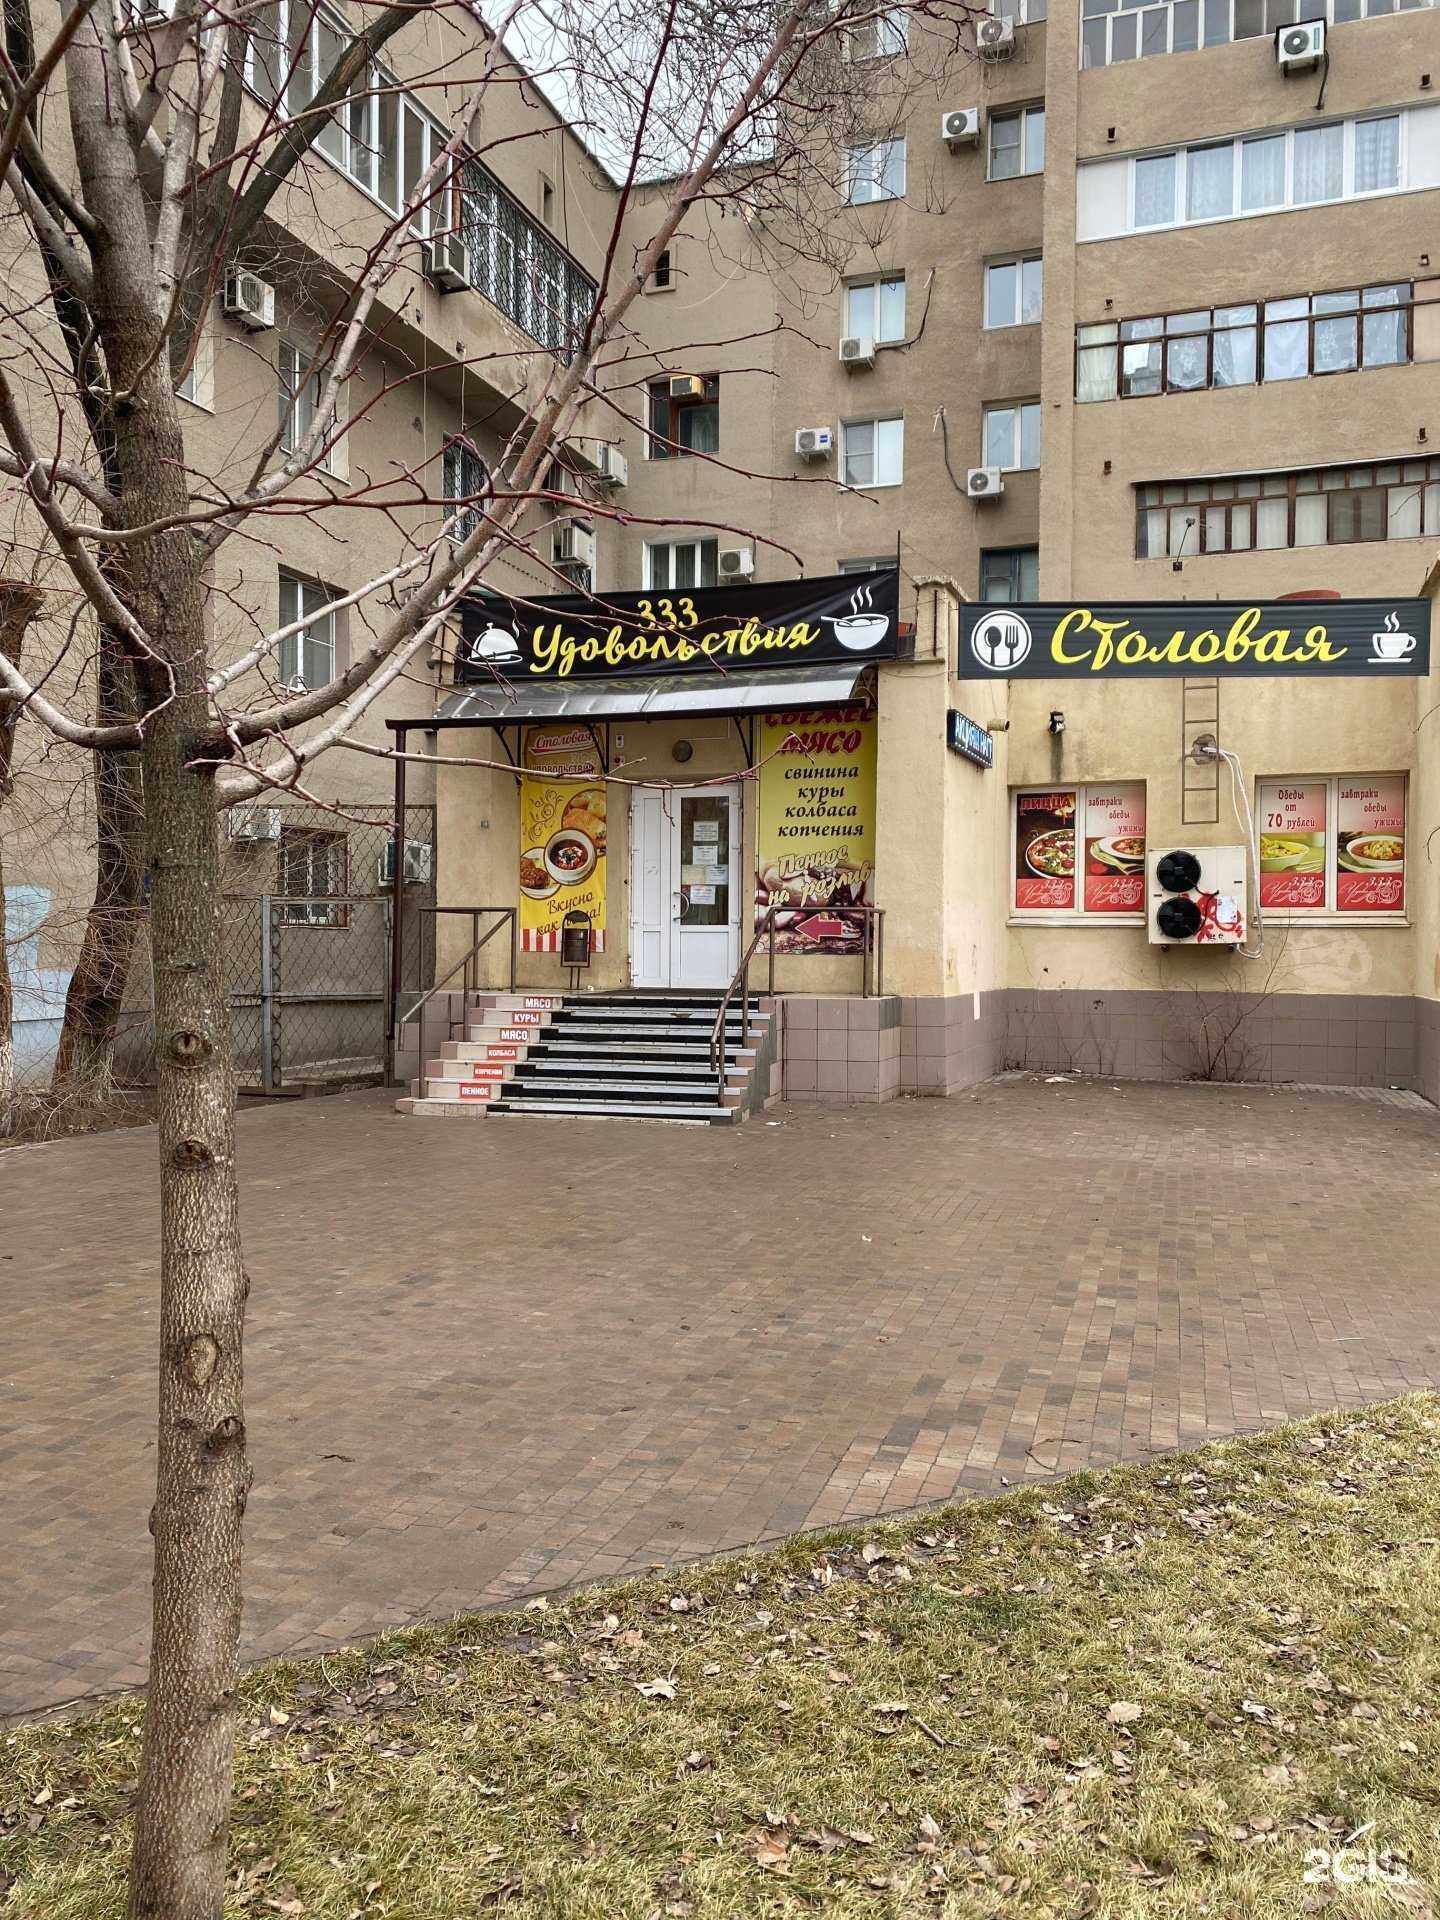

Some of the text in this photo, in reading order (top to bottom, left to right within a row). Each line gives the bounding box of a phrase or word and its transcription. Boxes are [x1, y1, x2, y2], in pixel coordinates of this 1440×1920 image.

[637, 598, 699, 630] 333
[1051, 608, 1347, 670] Столовая
[530, 616, 822, 678] Удовольствия
[780, 730, 863, 755] МЯСО
[784, 764, 858, 779] свинина
[798, 784, 845, 804] куры
[1278, 790, 1305, 800] Обеды
[1340, 788, 1379, 800] завтраки
[1088, 797, 1123, 807] завтраки
[1285, 803, 1297, 811] от
[1363, 802, 1387, 812] обеды
[785, 802, 857, 818] колбаса
[1109, 810, 1130, 819] обеды
[1267, 813, 1315, 830] 70 рублей
[778, 823, 864, 838] копчения
[778, 845, 849, 880] Пенное
[768, 861, 872, 907] на розлив
[547, 892, 593, 914] Вкусно
[537, 920, 561, 935] как
[525, 998, 551, 1008] МЯСО
[514, 1013, 539, 1023] КУРЫ
[501, 1029, 528, 1040] МЯСО
[488, 1049, 515, 1057] КОЛБАСА
[461, 1087, 489, 1096] ПЕННОЕ
